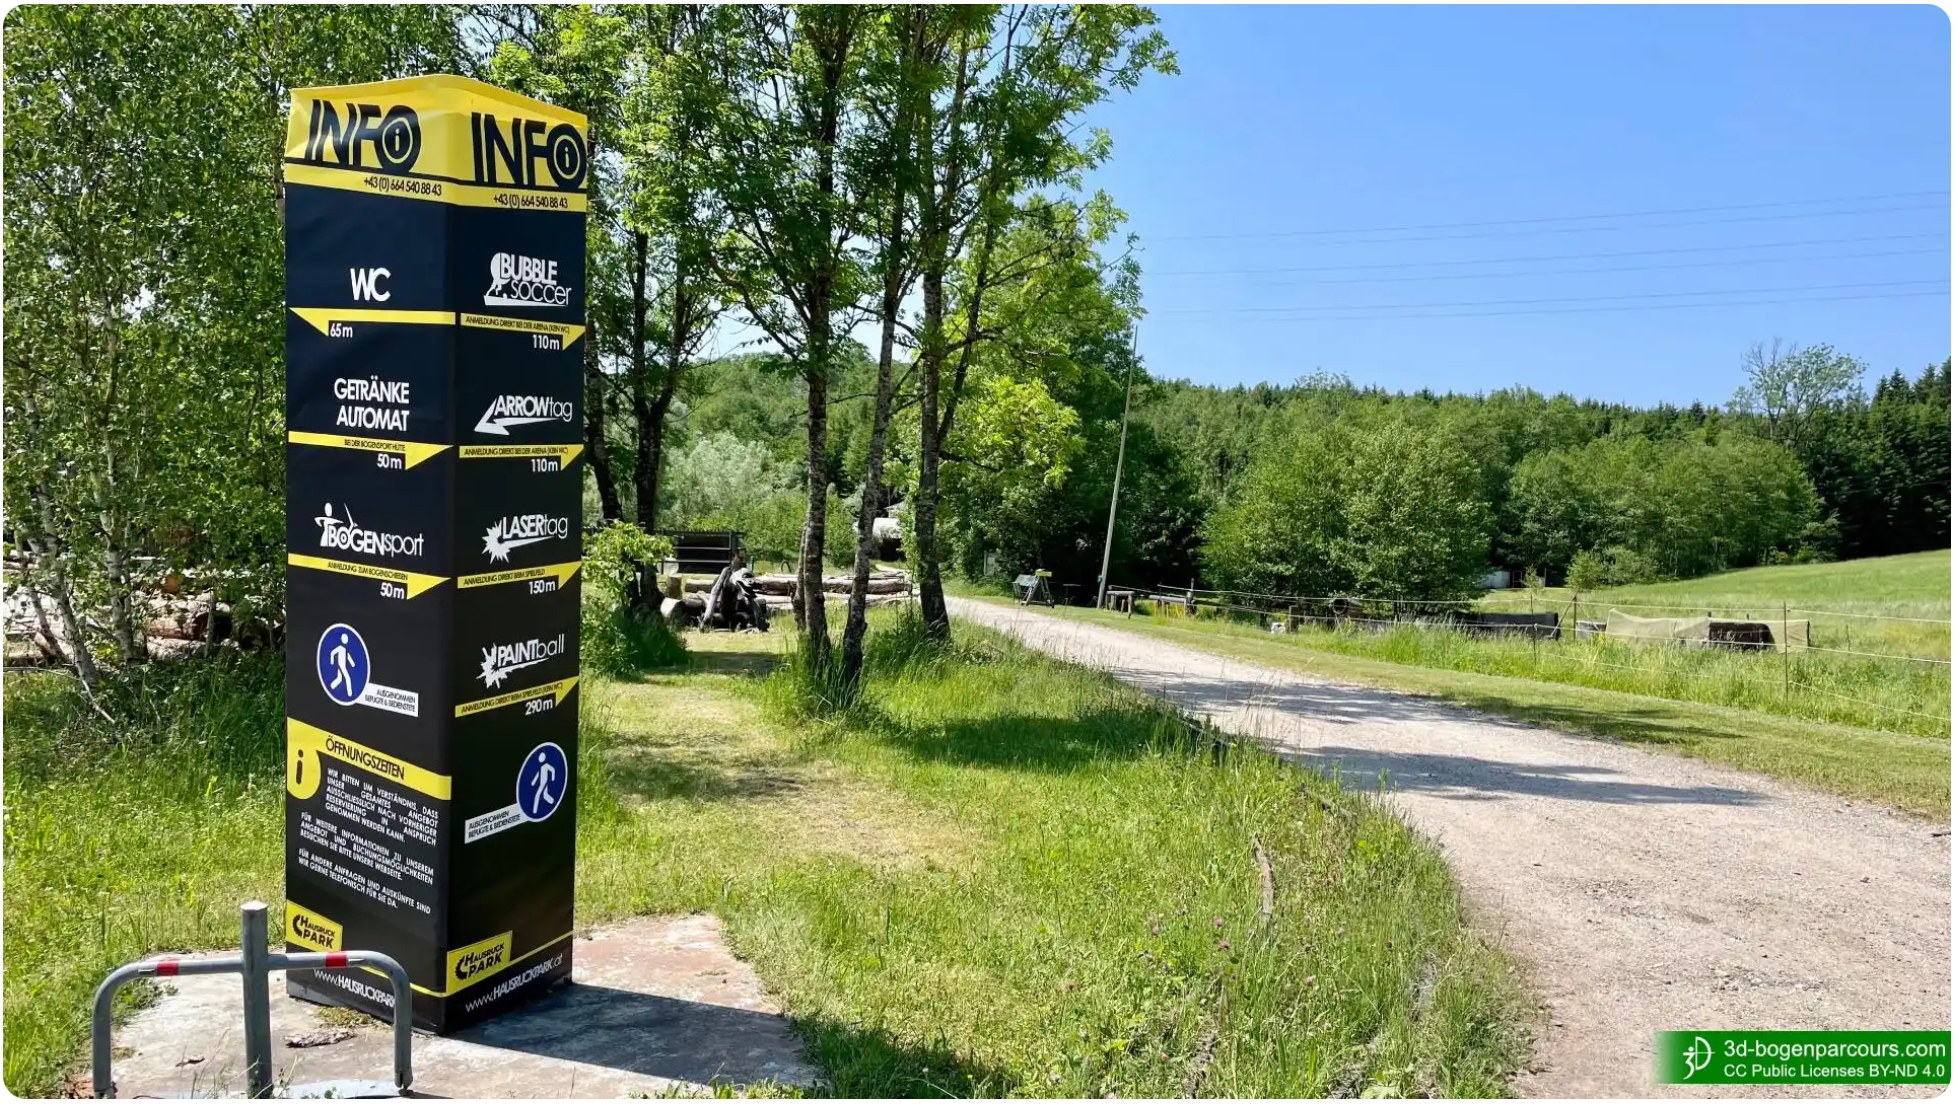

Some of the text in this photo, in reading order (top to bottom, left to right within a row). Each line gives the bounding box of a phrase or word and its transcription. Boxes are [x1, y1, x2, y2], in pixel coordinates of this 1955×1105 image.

[304, 99, 421, 173] INFO
[471, 112, 587, 190] INFO
[364, 178, 442, 196] +43 (0) 664 540 88 43
[494, 194, 568, 208] +43 (0) 664 540 88 43
[350, 267, 391, 301] WC
[500, 253, 557, 285] BUBBLE
[334, 375, 409, 404] GETRÄNKE
[336, 405, 410, 431] AUTOMAT
[326, 735, 405, 780] ÖFFNUNGSZEITEN
[327, 768, 439, 819] WIR BITTEN UM VERSTÄNDNIS, DASS
[327, 776, 438, 828] UNSER GESAMTES ANGEBOT
[327, 785, 437, 837] AUSSCHLIESSLICH NACH VORHERIGER
[301, 812, 434, 876] FÜR WEITERE INFORMATIONEN ZU UNSEREM
[325, 803, 405, 843] GENOMMEN WERDEN KANN.
[326, 794, 436, 847] RESERVIERUNG IN ANSPRUCH
[300, 821, 433, 885] ANGEBOT UND BUCHUNGSMÖGLICHKEITEN
[300, 829, 328, 847] BESUCHEN
[339, 845, 352, 858] BITTE
[353, 852, 374, 867] UNSERE
[375, 862, 402, 880] WEBSEITE.
[298, 857, 398, 909] WIR GERNE TELEFONISCH FÜR SIE DA.
[299, 848, 430, 914] FÜR ANDERE ANFRAGEN UND AUSKÜNFTE SIND
[303, 931, 334, 948] PARK
[469, 951, 503, 977] PARK
